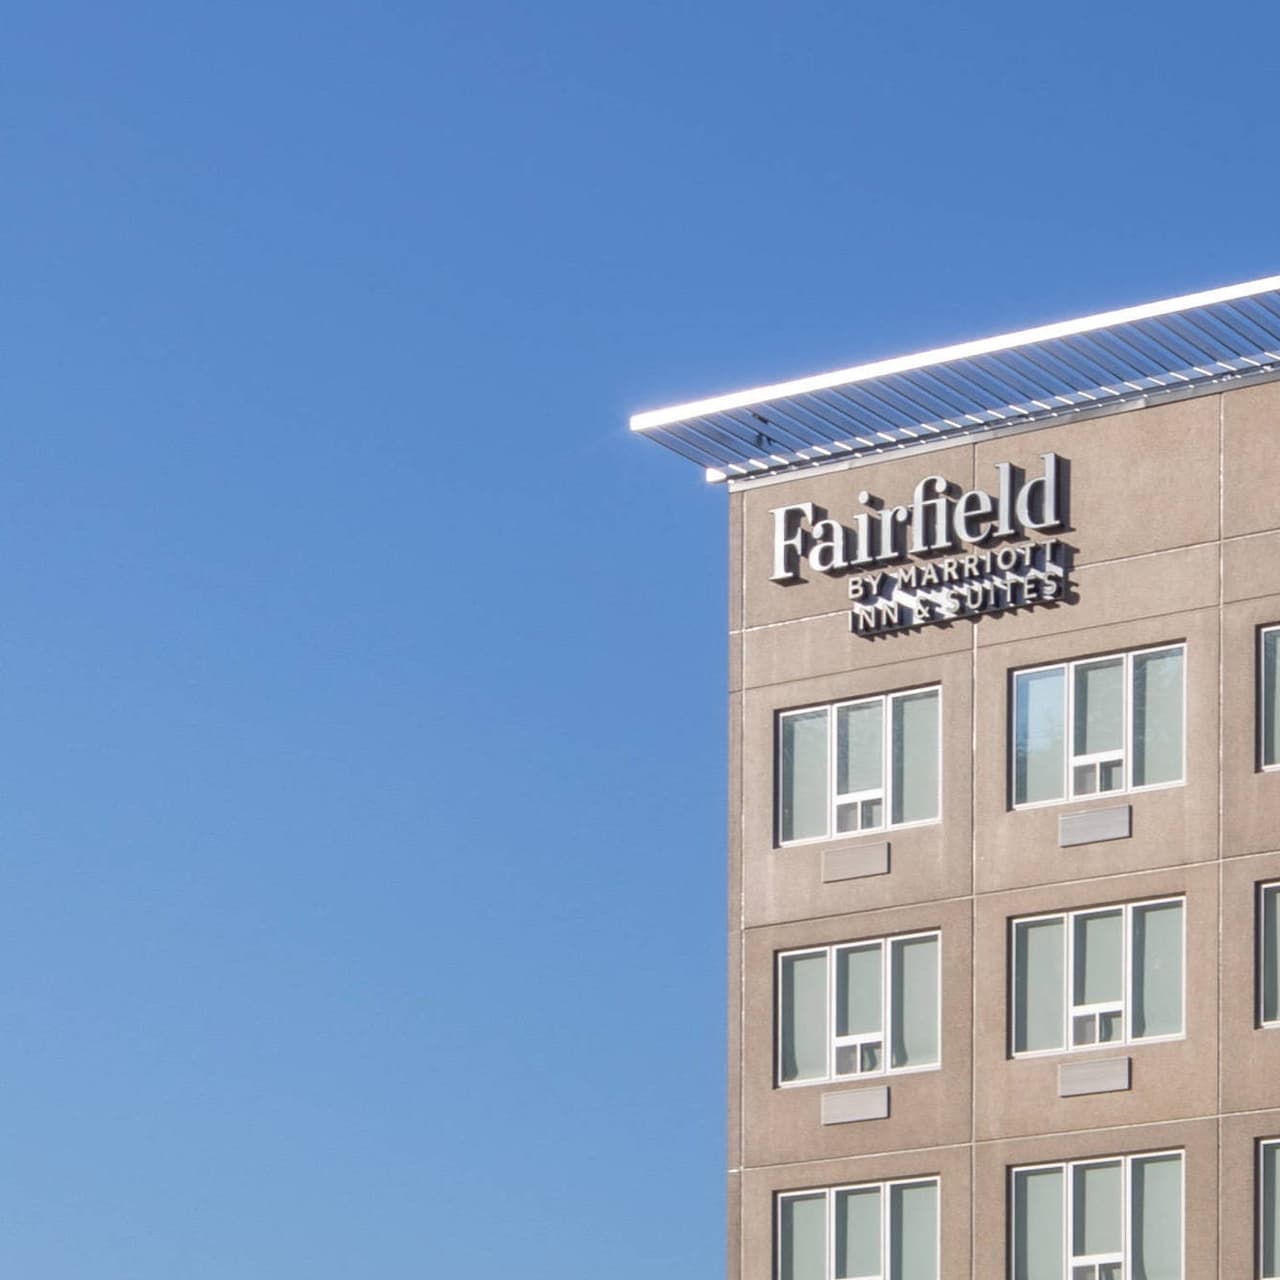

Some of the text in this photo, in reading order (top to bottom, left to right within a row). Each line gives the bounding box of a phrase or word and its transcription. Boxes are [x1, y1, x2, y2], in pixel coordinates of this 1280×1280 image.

[769, 453, 1060, 581] Fairfield
[849, 539, 1057, 599] BY MARRIOTT
[849, 572, 1058, 632] INN & SUITES
